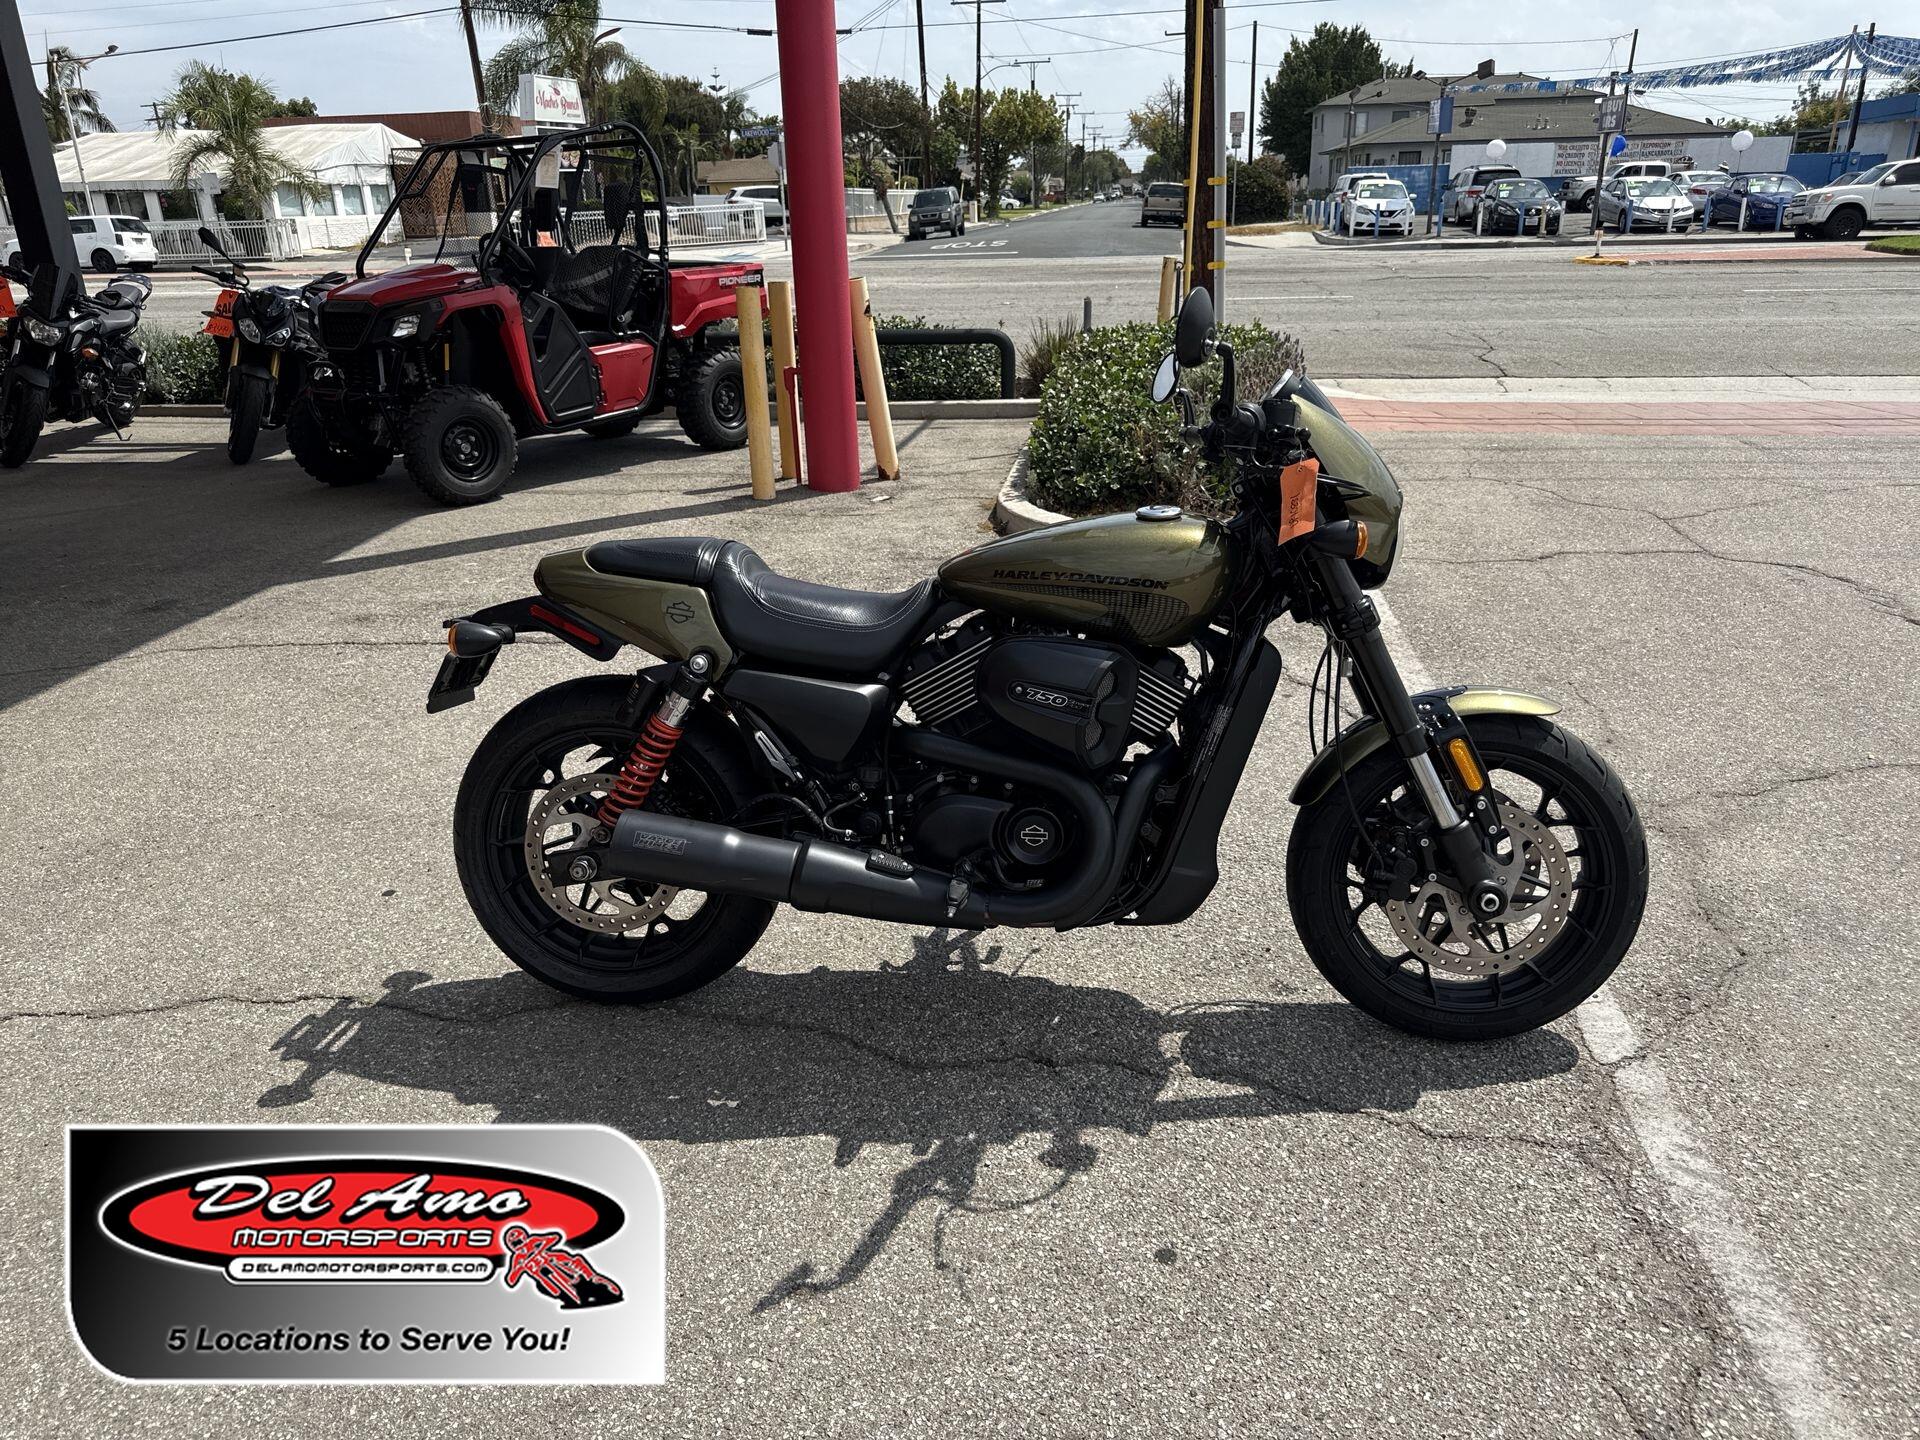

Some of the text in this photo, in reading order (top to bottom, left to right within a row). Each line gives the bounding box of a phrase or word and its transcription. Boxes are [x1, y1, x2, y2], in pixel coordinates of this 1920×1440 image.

[930, 240, 1009, 250] STOP
[718, 274, 762, 287] PIONEER
[992, 569, 1170, 590] HARLEY-DAVIDSON
[1026, 687, 1069, 707] 750
